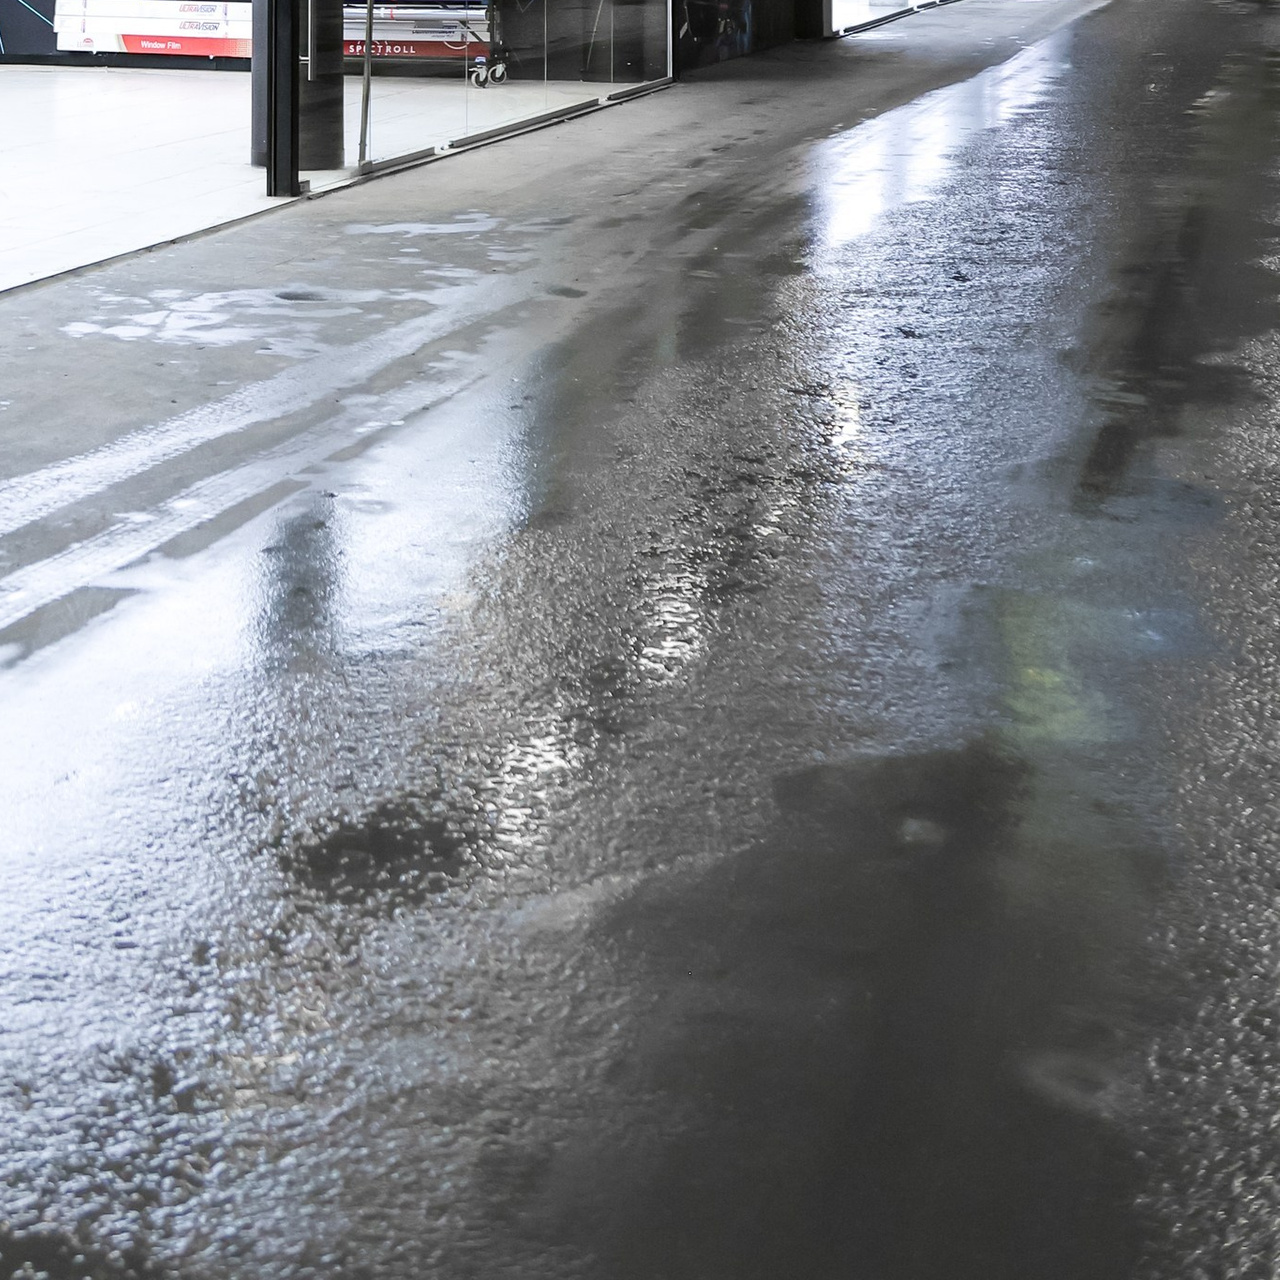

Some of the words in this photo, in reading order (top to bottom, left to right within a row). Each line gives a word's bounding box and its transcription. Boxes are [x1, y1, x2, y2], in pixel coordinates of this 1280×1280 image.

[140, 40, 166, 49] Window
[167, 41, 182, 50] Film
[348, 44, 416, 54] SPCTROLL
